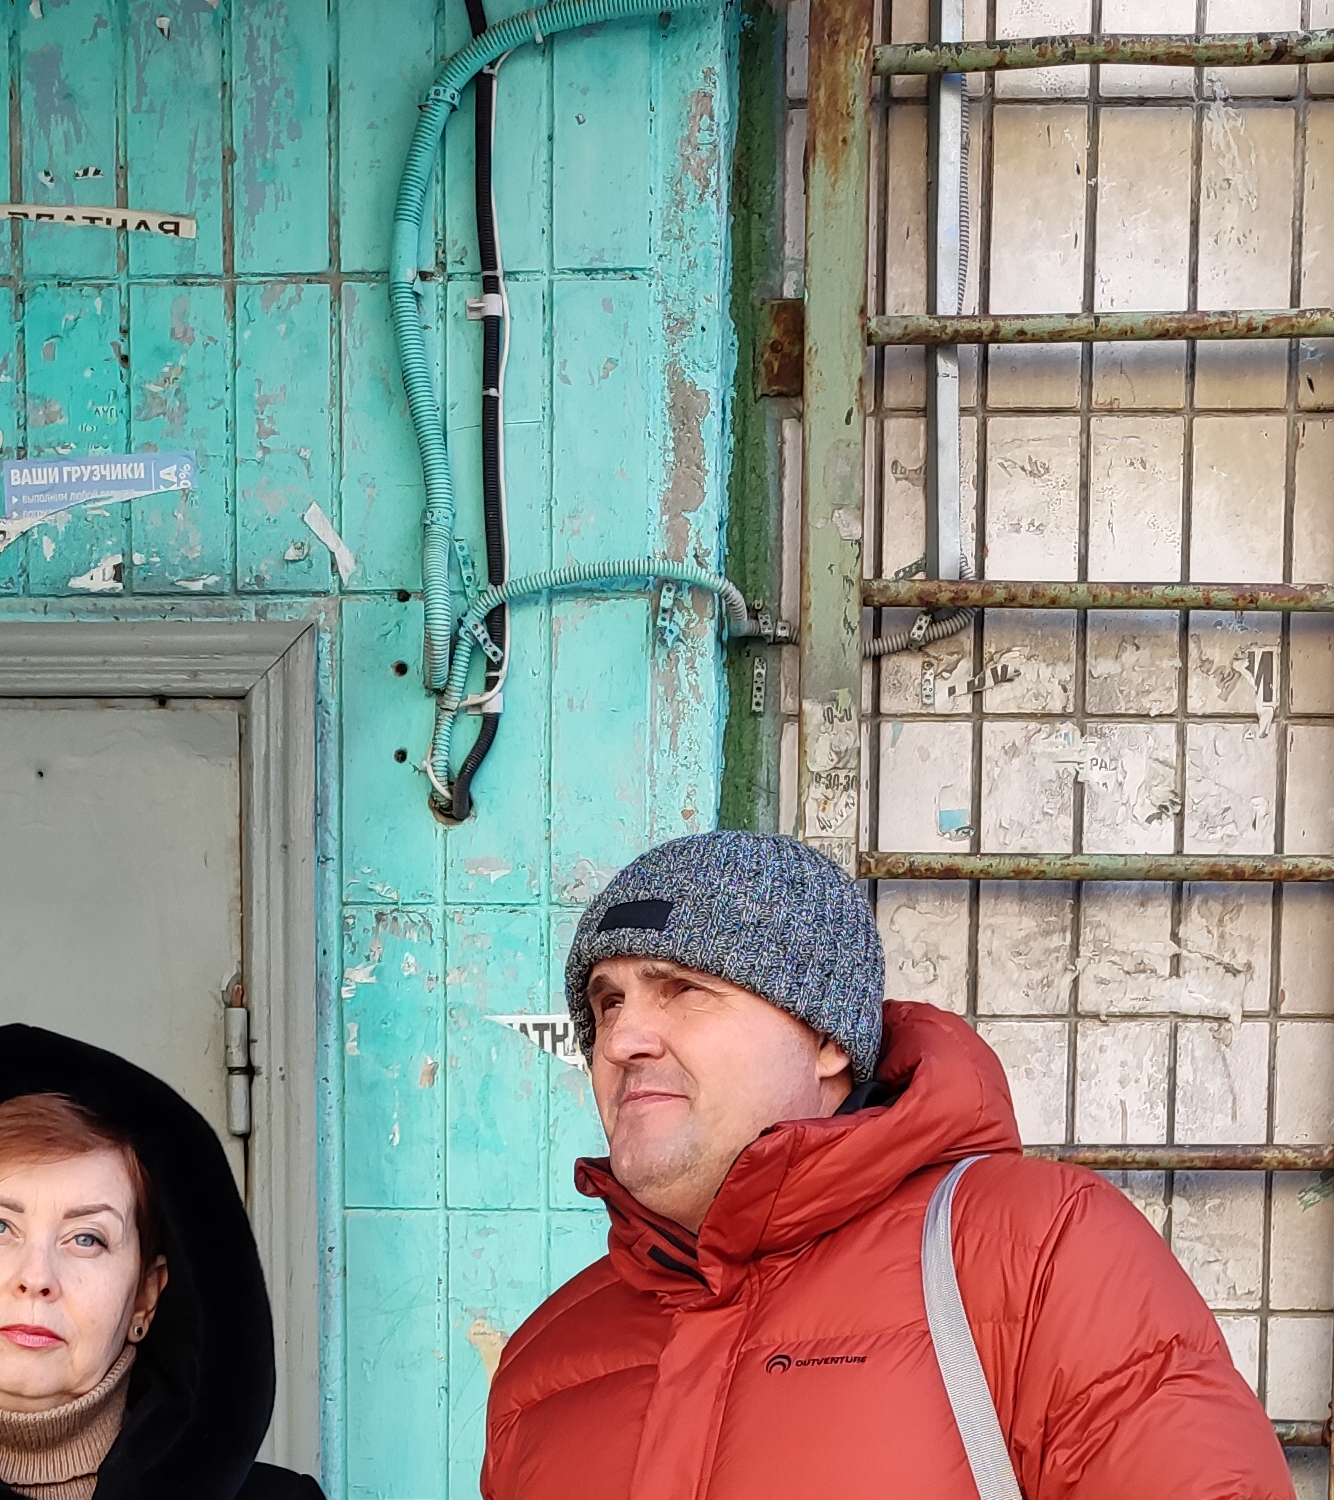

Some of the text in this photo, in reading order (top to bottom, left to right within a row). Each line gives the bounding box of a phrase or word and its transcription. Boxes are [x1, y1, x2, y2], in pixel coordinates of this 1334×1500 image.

[10, 461, 145, 486] ВАШИ ГРУЗЧИКИ
[795, 1355, 868, 1368] OUTVENTURE
